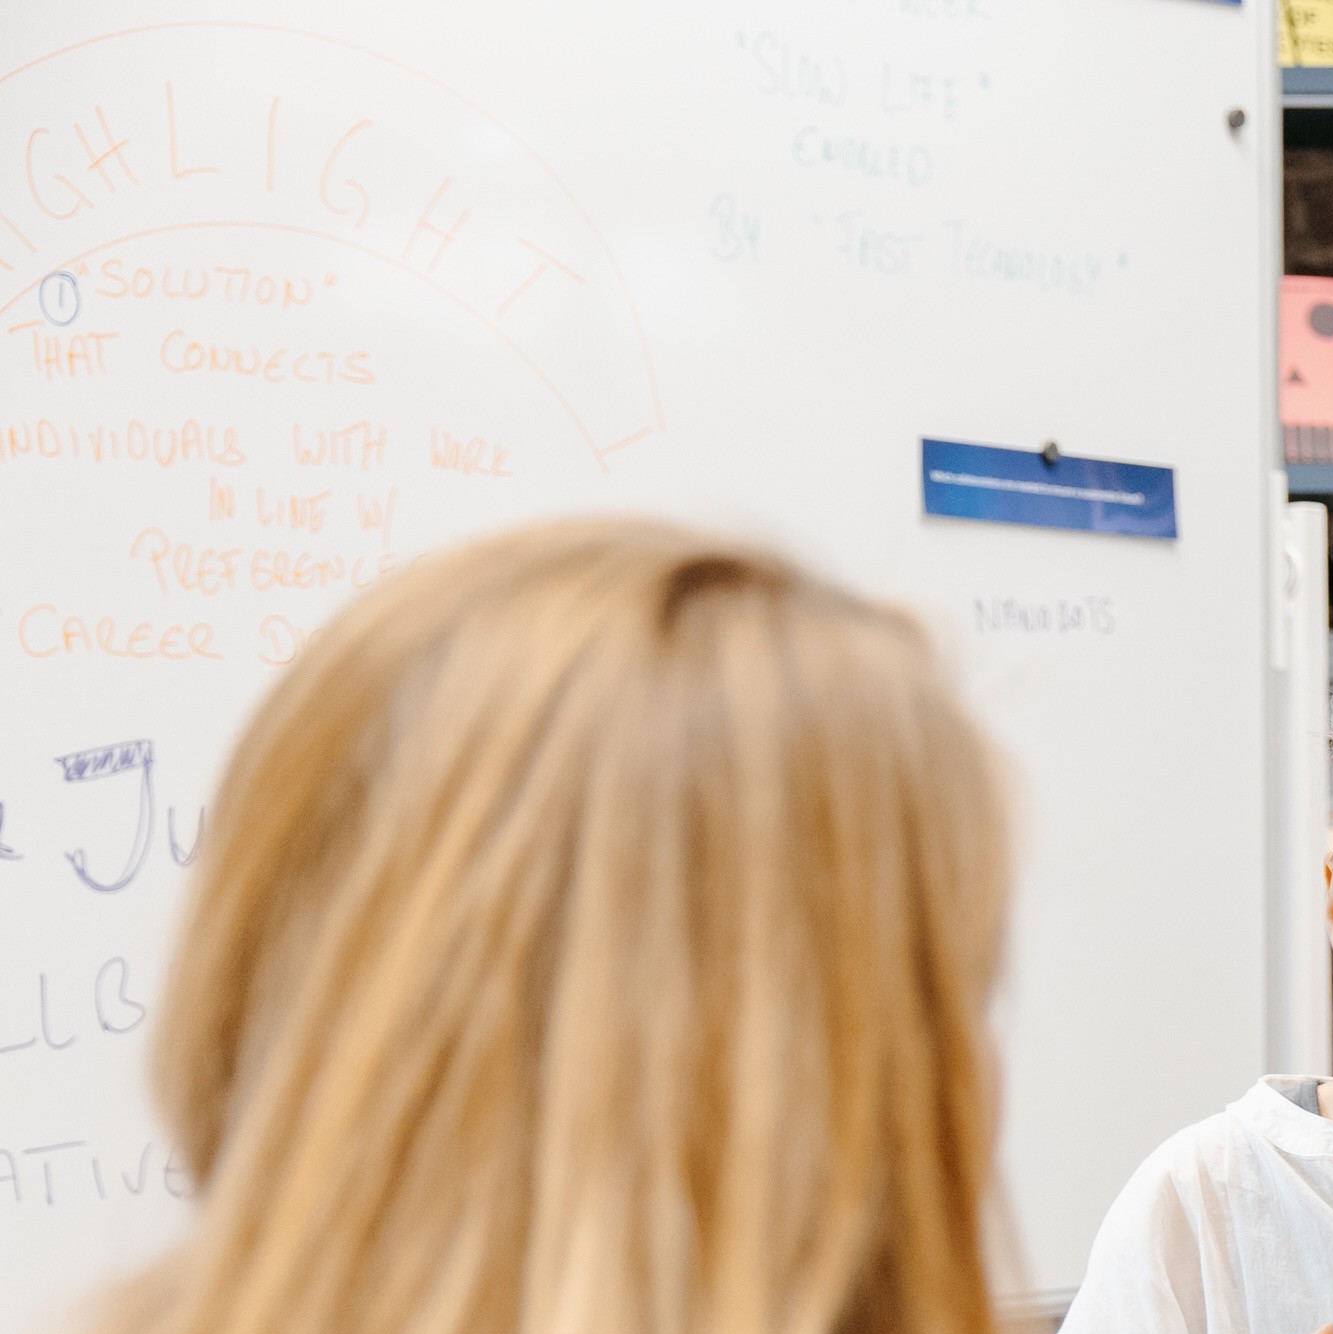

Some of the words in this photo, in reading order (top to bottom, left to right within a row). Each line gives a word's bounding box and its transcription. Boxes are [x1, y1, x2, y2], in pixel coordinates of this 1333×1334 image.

[8, 320, 120, 381] THAT
[160, 329, 377, 384] CONNECTS
[292, 419, 387, 470] WITH
[18, 604, 224, 662] CAREER
